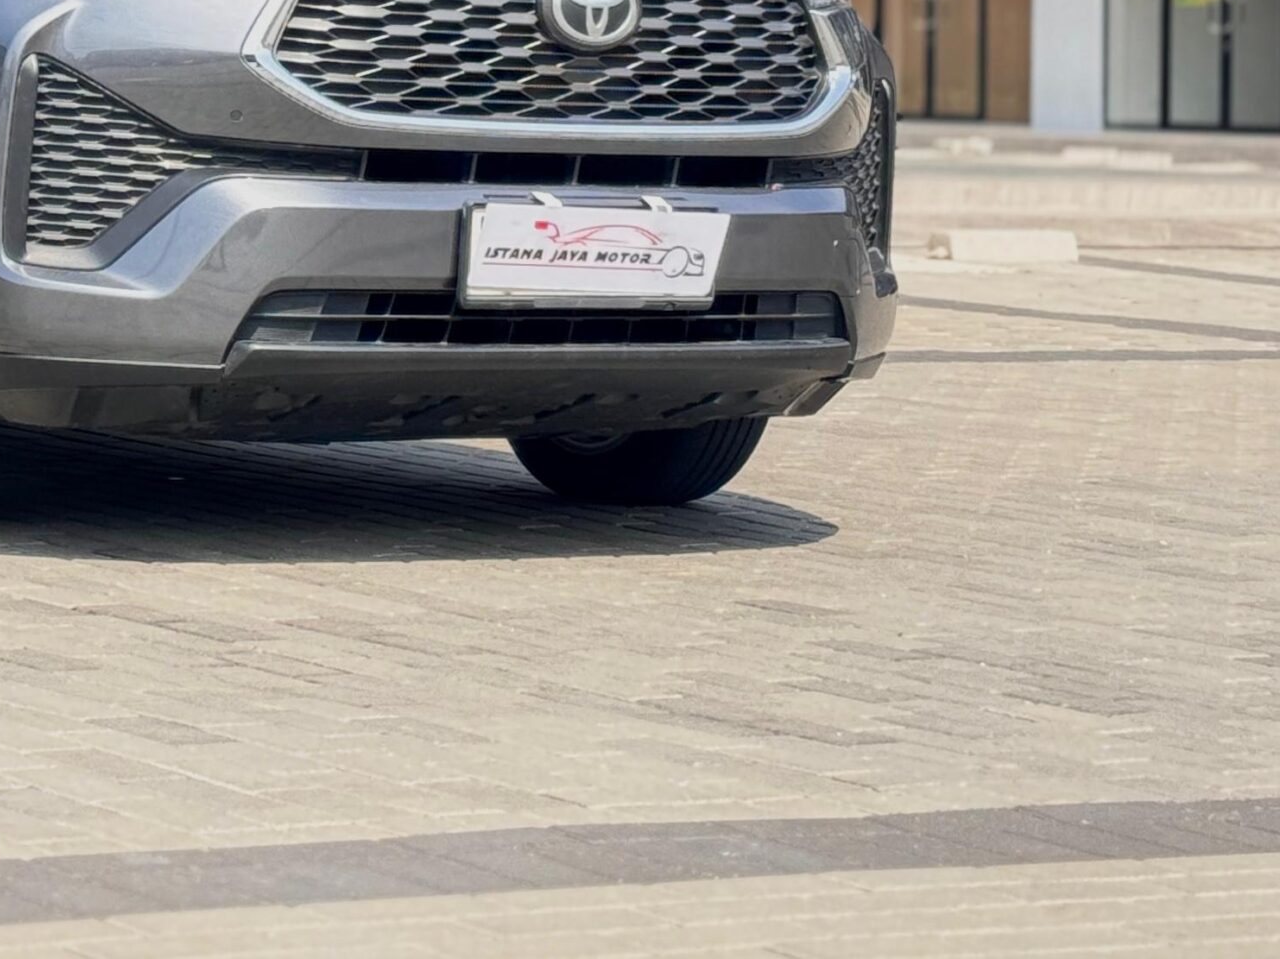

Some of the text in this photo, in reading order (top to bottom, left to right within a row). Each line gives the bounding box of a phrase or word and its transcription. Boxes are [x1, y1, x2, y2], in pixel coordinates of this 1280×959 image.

[484, 246, 652, 265] ISTANA JAYA MOTOR
